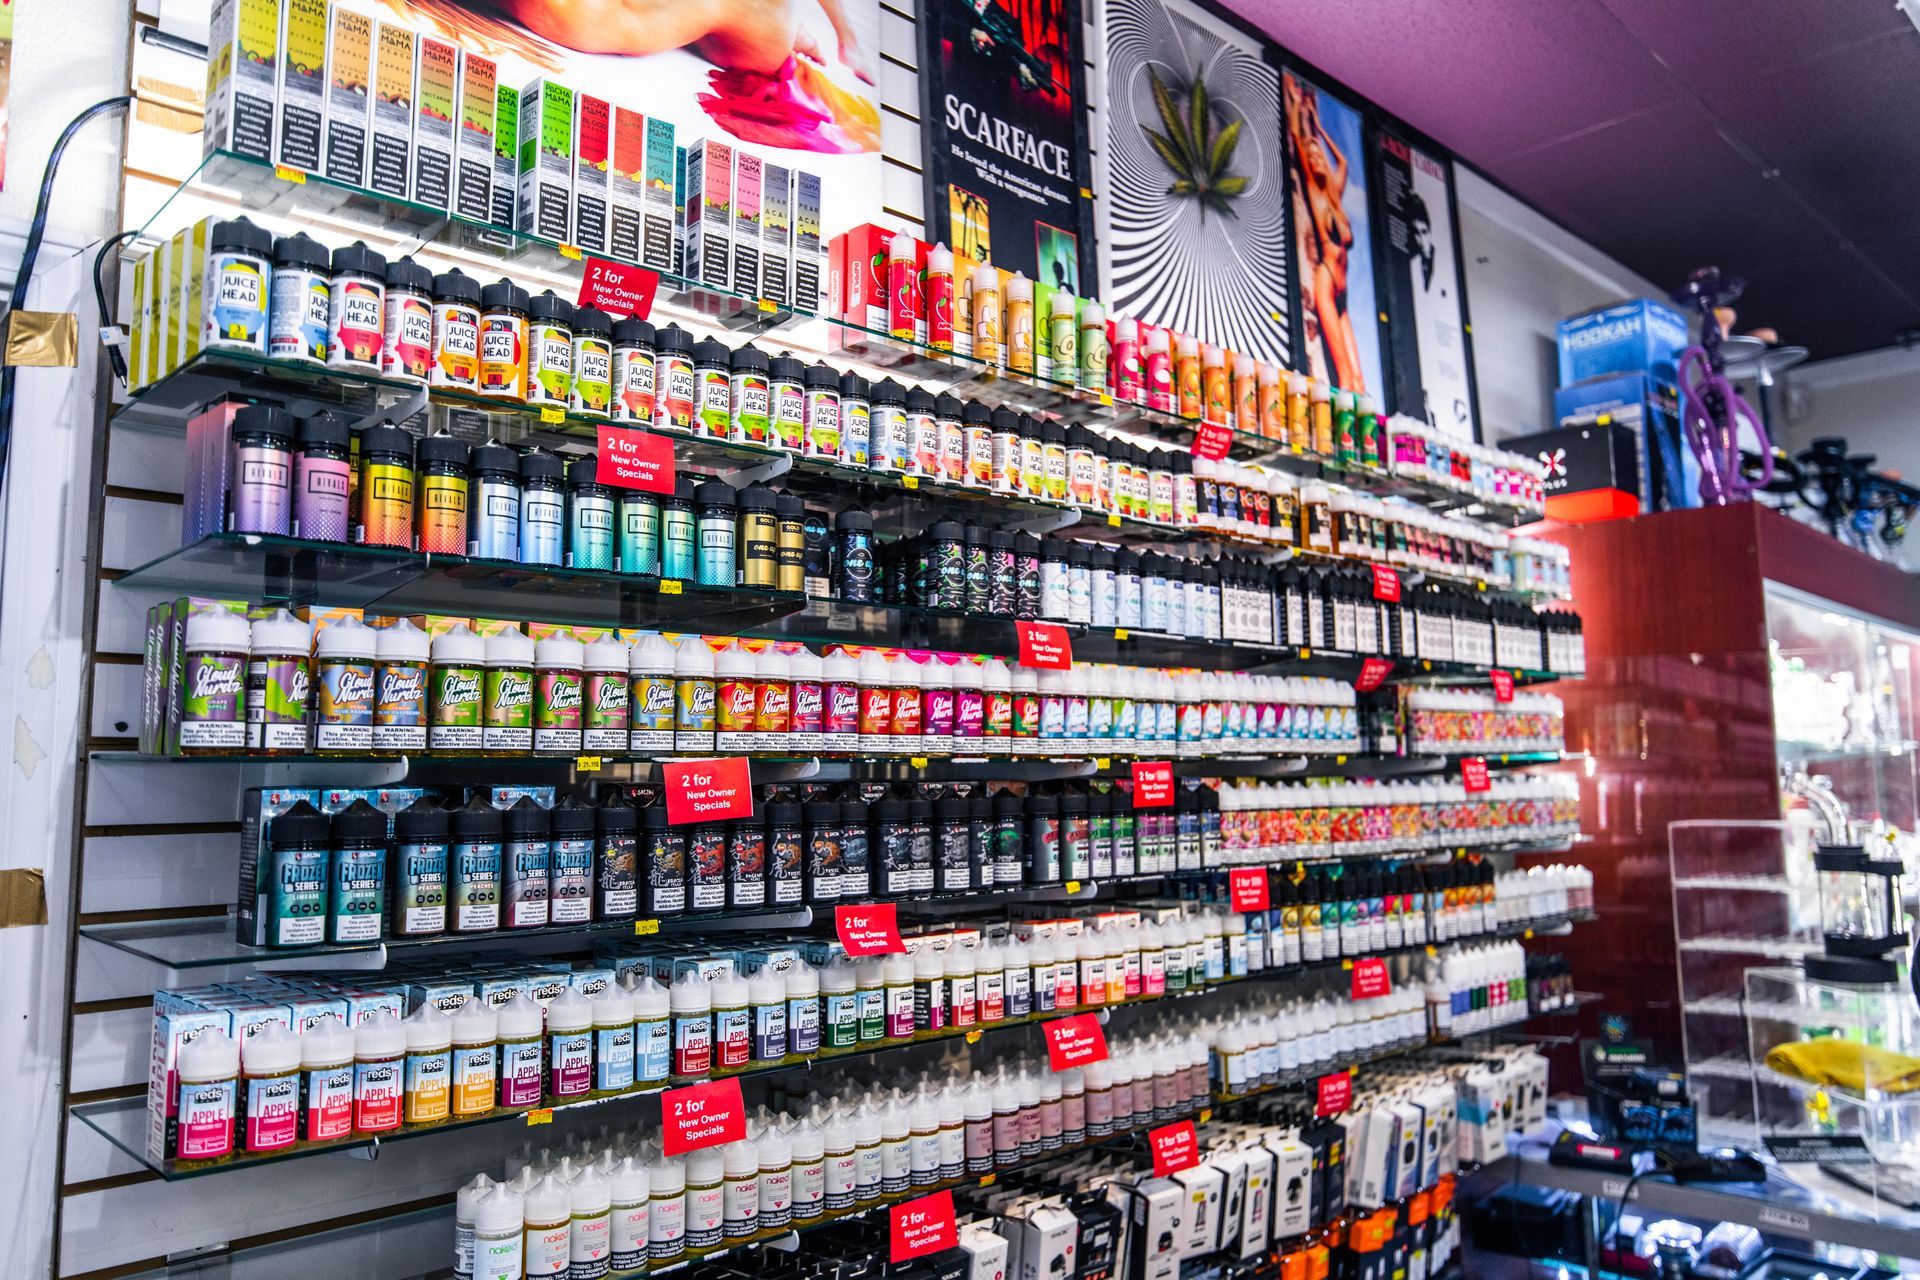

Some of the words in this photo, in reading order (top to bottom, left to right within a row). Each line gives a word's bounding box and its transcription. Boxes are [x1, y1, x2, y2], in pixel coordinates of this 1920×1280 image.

[381, 35, 410, 51] MAMA
[944, 94, 1072, 181] SCARFACE
[951, 144, 964, 158] He
[965, 151, 987, 169] loved
[989, 164, 1002, 176] the
[1003, 170, 1041, 192] American
[1043, 186, 1071, 204] dream.
[976, 167, 997, 184] With
[592, 268, 601, 280] 2
[605, 270, 624, 284] for
[223, 276, 256, 290] JUICE
[223, 289, 256, 302] HEAD
[593, 283, 613, 294] New
[615, 288, 644, 302] Owner
[348, 300, 378, 313] JUICE
[596, 295, 634, 310] Specials
[348, 312, 377, 325] HEAD
[449, 326, 475, 340] JUICE
[484, 333, 510, 345] JUICE
[449, 338, 475, 351] HEAD
[484, 348, 510, 357] HEAD
[584, 356, 608, 368] JUICE
[584, 366, 608, 378] HEAD
[631, 366, 652, 378] JUICE
[631, 378, 652, 389] HEAD
[746, 392, 766, 402] JUICE
[746, 402, 766, 412] HEAD
[818, 407, 837, 417] JUICE
[818, 418, 837, 426] HEAD
[608, 438, 615, 450] 2
[619, 440, 638, 454] for
[611, 454, 630, 464] New
[632, 458, 660, 470] Owner
[617, 467, 653, 481] Specials
[844, 559, 864, 567] one
[1028, 631, 1034, 641] 2
[1035, 632, 1048, 642] for
[1032, 643, 1044, 652] New
[1045, 645, 1062, 654] Owner
[1036, 653, 1059, 663] Specials
[196, 661, 241, 681] Cloud
[383, 671, 420, 691] Cloud
[444, 673, 480, 691] Cloud
[499, 675, 531, 693] Cloud
[192, 680, 242, 699] Nurdz
[600, 680, 628, 699] Cloud
[379, 688, 423, 705] Nurdz
[439, 690, 481, 707] Nurdz
[495, 691, 532, 709] Nurdz
[682, 775, 690, 787] 2
[693, 774, 712, 786] for
[1139, 771, 1144, 781] 2
[687, 791, 706, 800] New
[708, 788, 736, 798] Owner
[694, 800, 731, 811] Specials
[472, 872, 493, 880] SERIES
[563, 867, 584, 875] SERIES
[295, 881, 319, 890] SERIES
[352, 880, 374, 889] SERIES
[845, 917, 852, 928] 2
[854, 916, 868, 927] for
[850, 932, 865, 940] New
[865, 930, 887, 938] Owner
[859, 940, 888, 948] Specials
[583, 980, 606, 991] reds
[438, 994, 463, 1006] reds
[690, 1022, 707, 1030] reds
[1054, 1030, 1061, 1040] 2
[1062, 1027, 1076, 1038] for
[567, 1040, 586, 1048] reds
[688, 1037, 708, 1049] APPLE
[1059, 1042, 1073, 1050] New
[1074, 1037, 1094, 1047] Owner
[1066, 1048, 1093, 1060] Specials
[422, 1060, 444, 1070] reds
[565, 1056, 588, 1068] APPLE
[368, 1068, 392, 1078] reds
[267, 1082, 292, 1093] reds
[420, 1078, 445, 1091] APPLE
[195, 1089, 223, 1100] reds
[365, 1087, 393, 1101] APPLE
[264, 1101, 292, 1118] APPLE
[675, 1103, 683, 1115] 2
[686, 1100, 705, 1112] for
[192, 1108, 223, 1124] APPLE
[679, 1118, 698, 1129] New
[701, 1111, 730, 1124] Owner
[686, 1125, 724, 1140] Specials
[1158, 1139, 1164, 1149] 2
[1164, 1136, 1176, 1147] for
[901, 1216, 908, 1227] 2
[910, 1212, 926, 1224] for
[904, 1229, 920, 1238] New
[921, 1221, 945, 1233] Owner
[544, 1230, 568, 1244] naked
[910, 1234, 941, 1248] Specials
